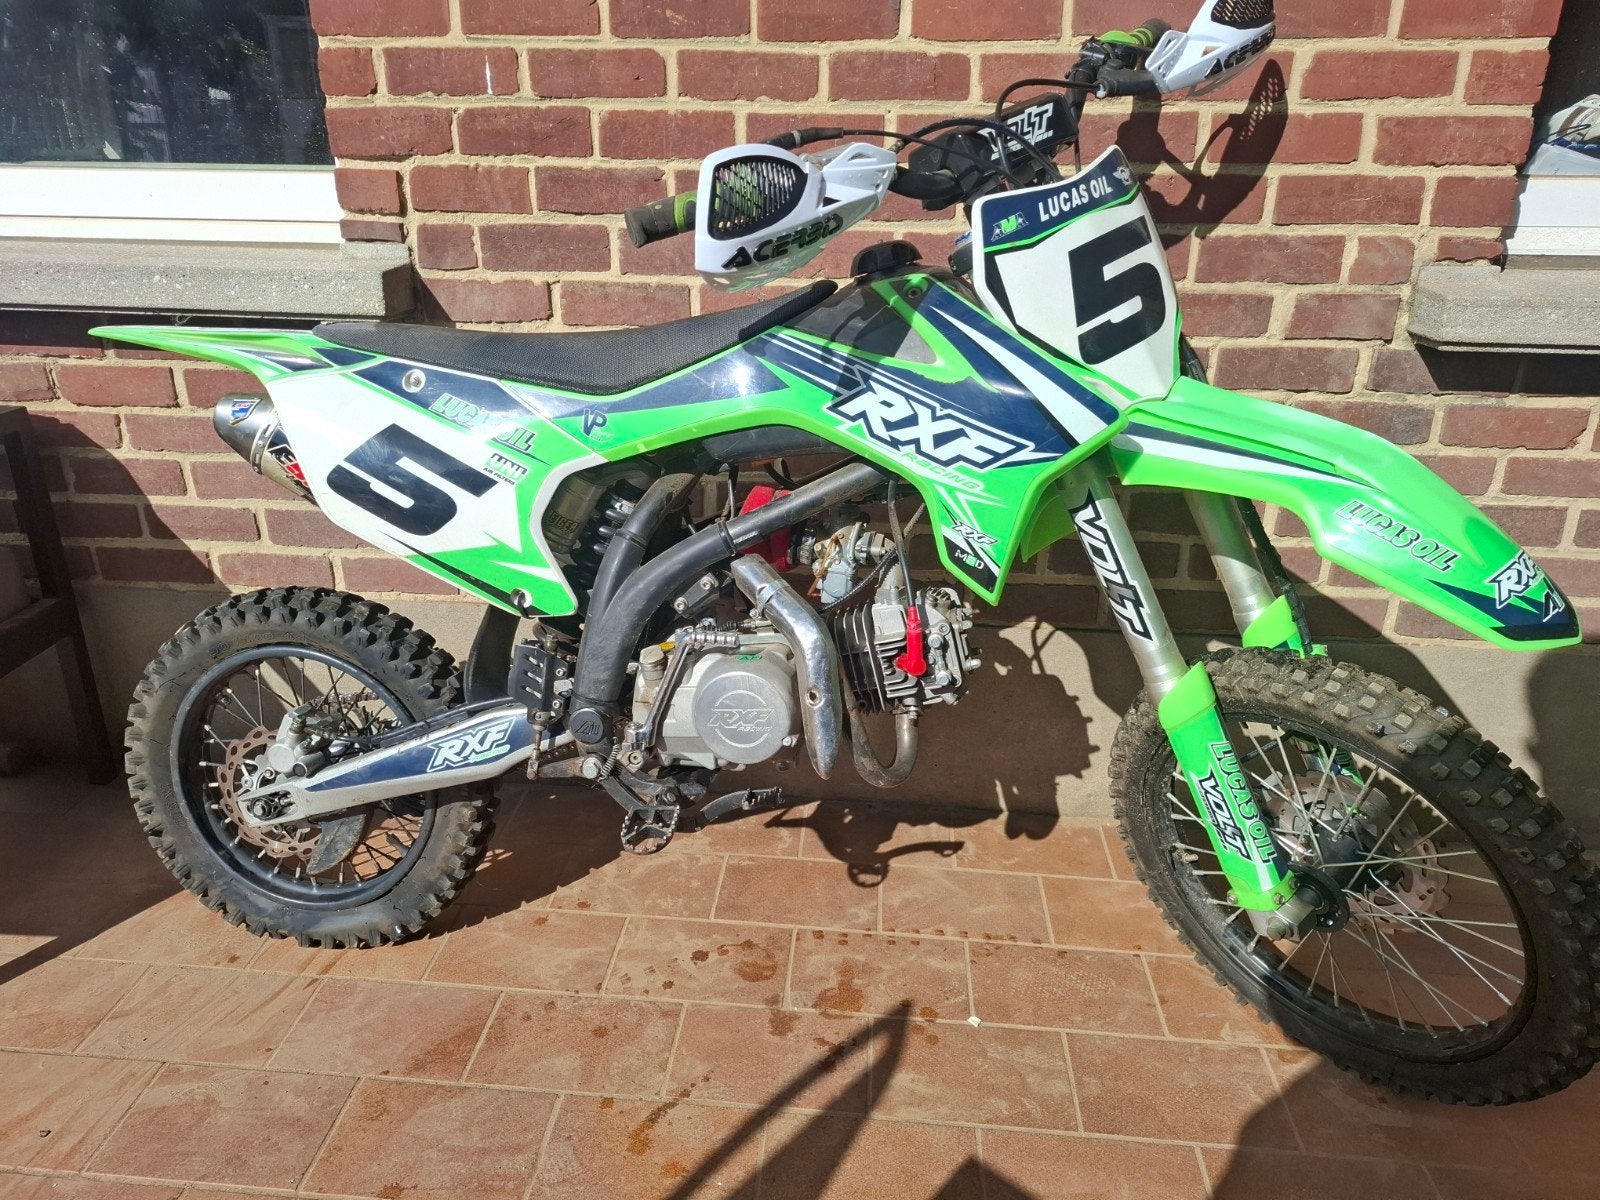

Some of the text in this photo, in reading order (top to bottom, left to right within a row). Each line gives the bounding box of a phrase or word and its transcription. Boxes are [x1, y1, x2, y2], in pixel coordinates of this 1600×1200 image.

[1038, 175, 1114, 222] LUCAS OIL
[1068, 215, 1166, 365] 5
[429, 393, 501, 430] LUCA
[582, 407, 608, 437] VP
[832, 374, 1022, 468] RXF
[327, 423, 498, 536] 5
[952, 521, 998, 545] RXF
[1069, 488, 1154, 641] VOLT
[1336, 500, 1459, 572] LUCAS OIL
[429, 718, 514, 770] RXF
[708, 708, 775, 729] RXF
[1199, 768, 1253, 861] VOLT
[1210, 742, 1260, 820] LUCAS
[1248, 820, 1277, 864] OIL
